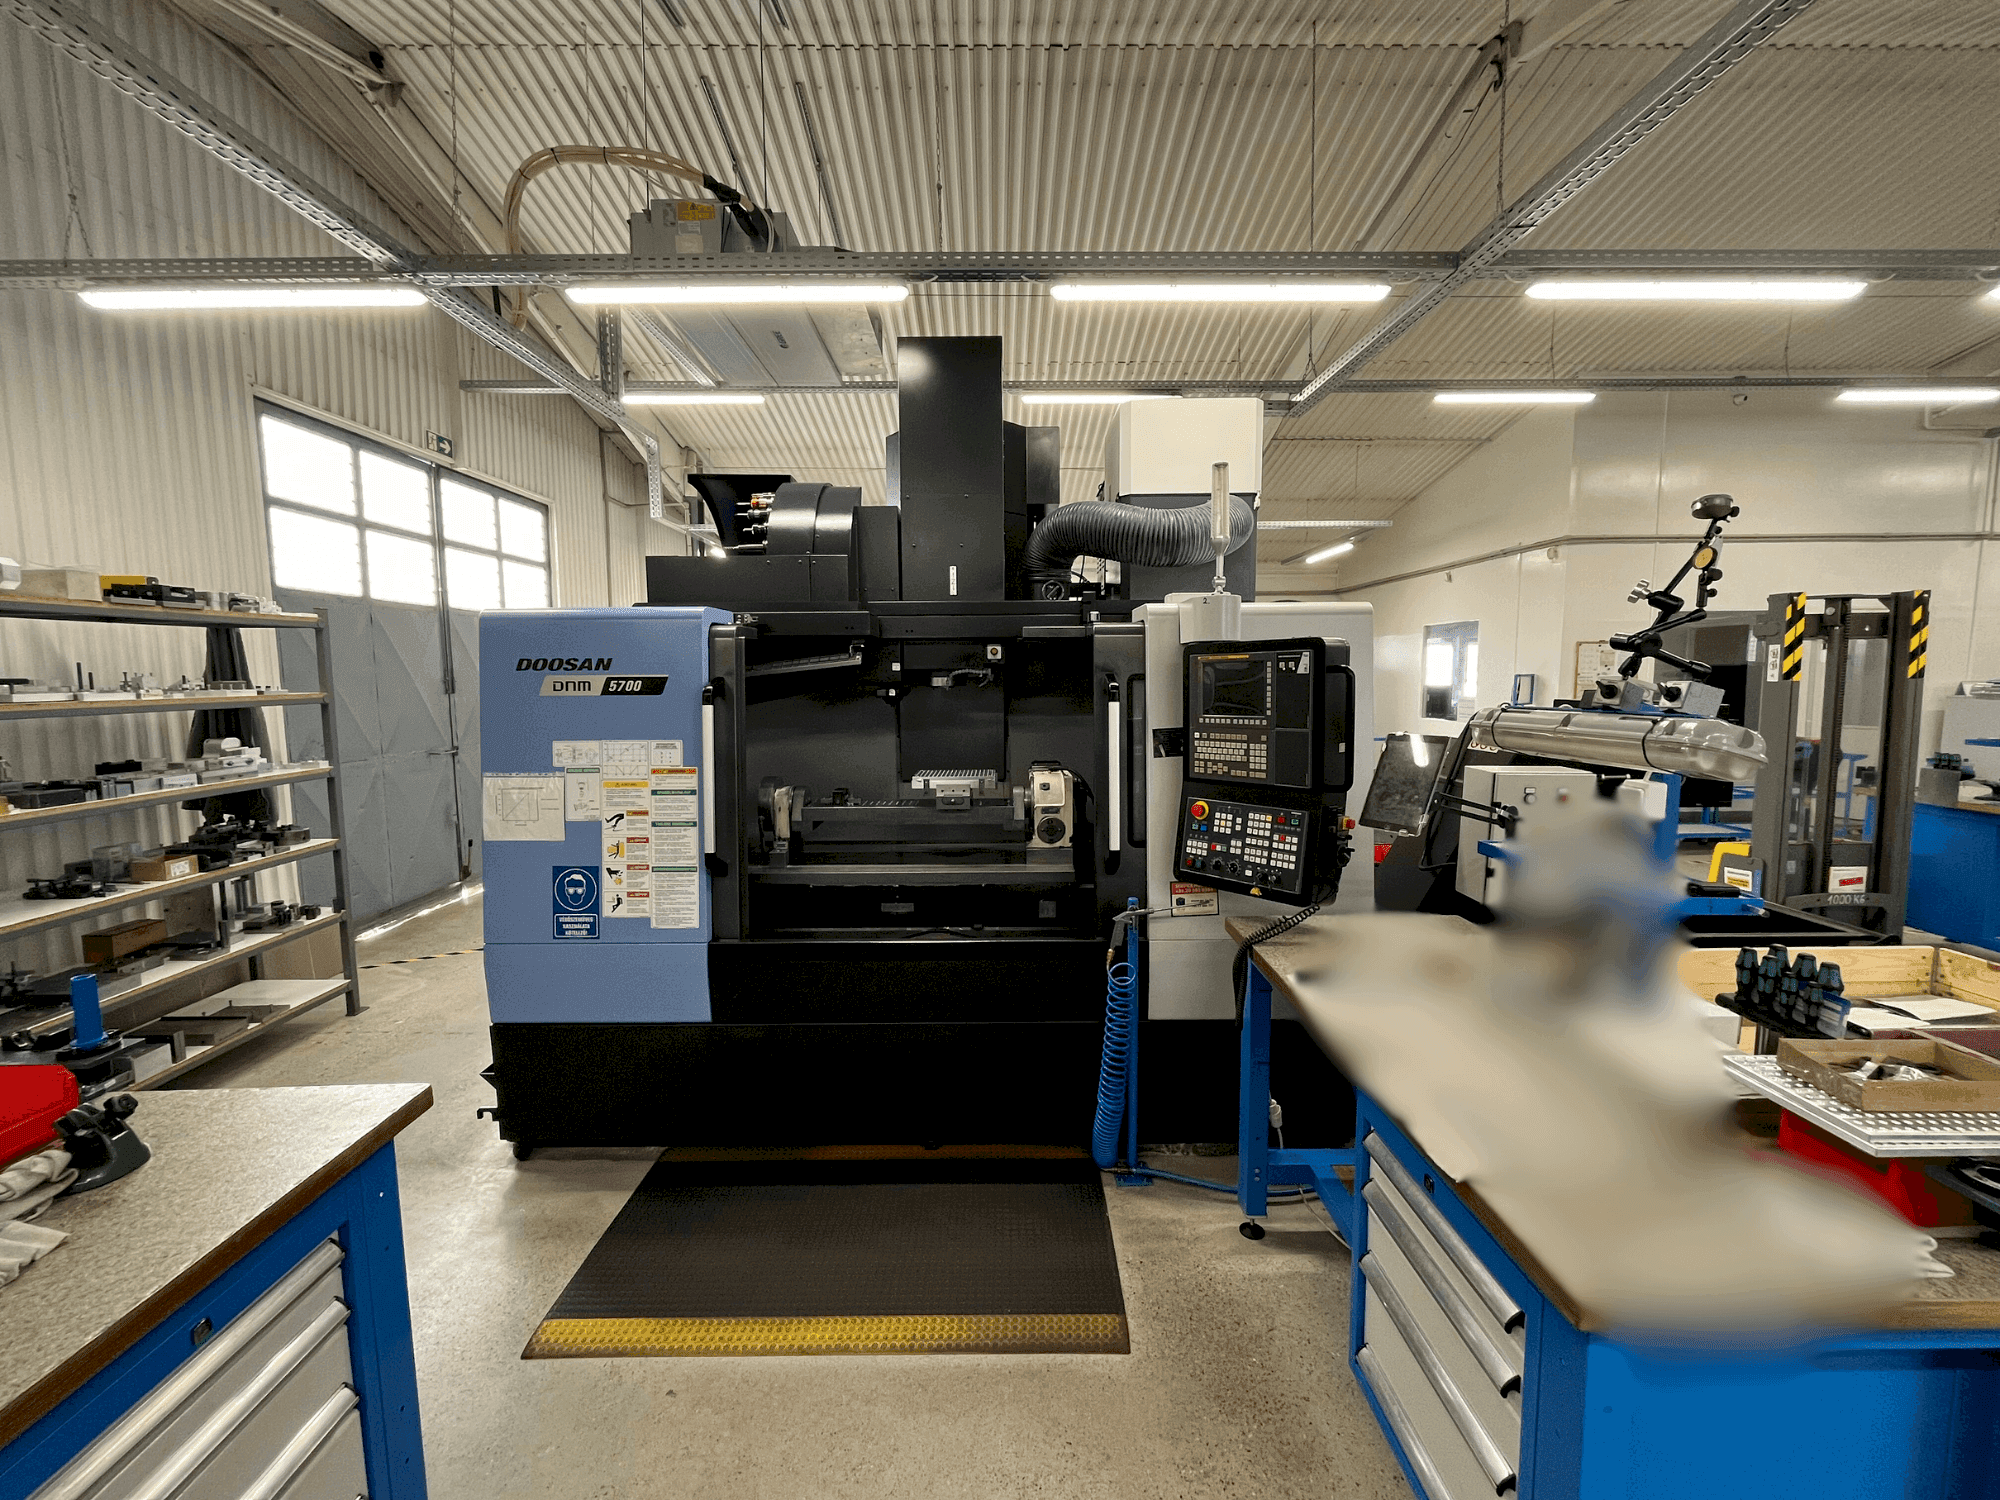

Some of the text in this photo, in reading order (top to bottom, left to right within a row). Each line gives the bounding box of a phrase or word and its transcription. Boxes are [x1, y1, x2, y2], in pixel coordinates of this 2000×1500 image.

[515, 657, 613, 672] DOOSAN
[608, 680, 643, 692] 5700
[1827, 894, 1852, 905] 1000
